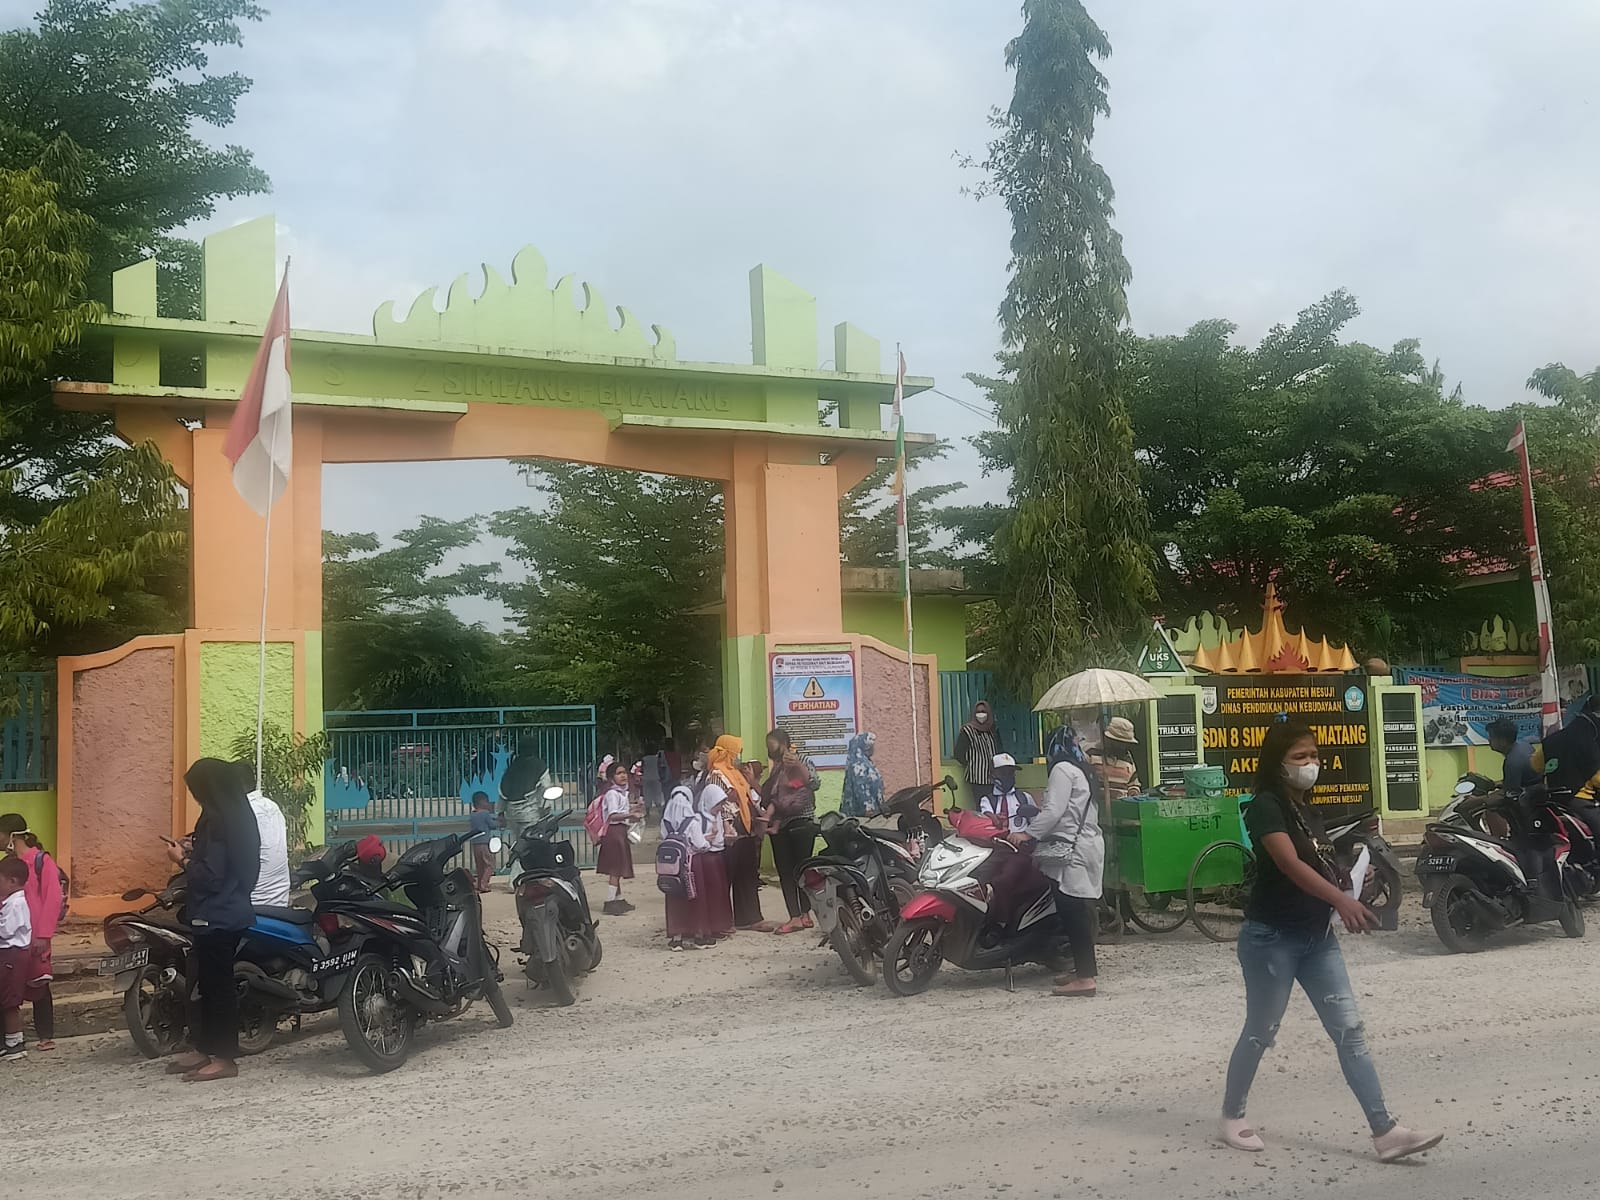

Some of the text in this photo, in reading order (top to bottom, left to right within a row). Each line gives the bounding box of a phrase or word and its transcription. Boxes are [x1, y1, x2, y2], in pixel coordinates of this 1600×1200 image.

[443, 362, 573, 403] SIMPANG
[1150, 653, 1169, 662] UKS
[1227, 686, 1335, 699] PEMERINTAH KABUPATEN MESUJI
[792, 701, 837, 710] PERHATIAN
[1220, 701, 1342, 714] DINAS PENDIDIKAN DAN KEBUDAYAAN
[1159, 726, 1195, 735] TRIAS UKS
[1203, 727, 1228, 748] SDN
[1230, 727, 1239, 747] 8
[1332, 755, 1343, 770] A
[1313, 783, 1370, 793] SIMPANG PEMATANG
[1310, 795, 1363, 805] ABUPATEN MESUJI
[320, 956, 340, 970] 3592
